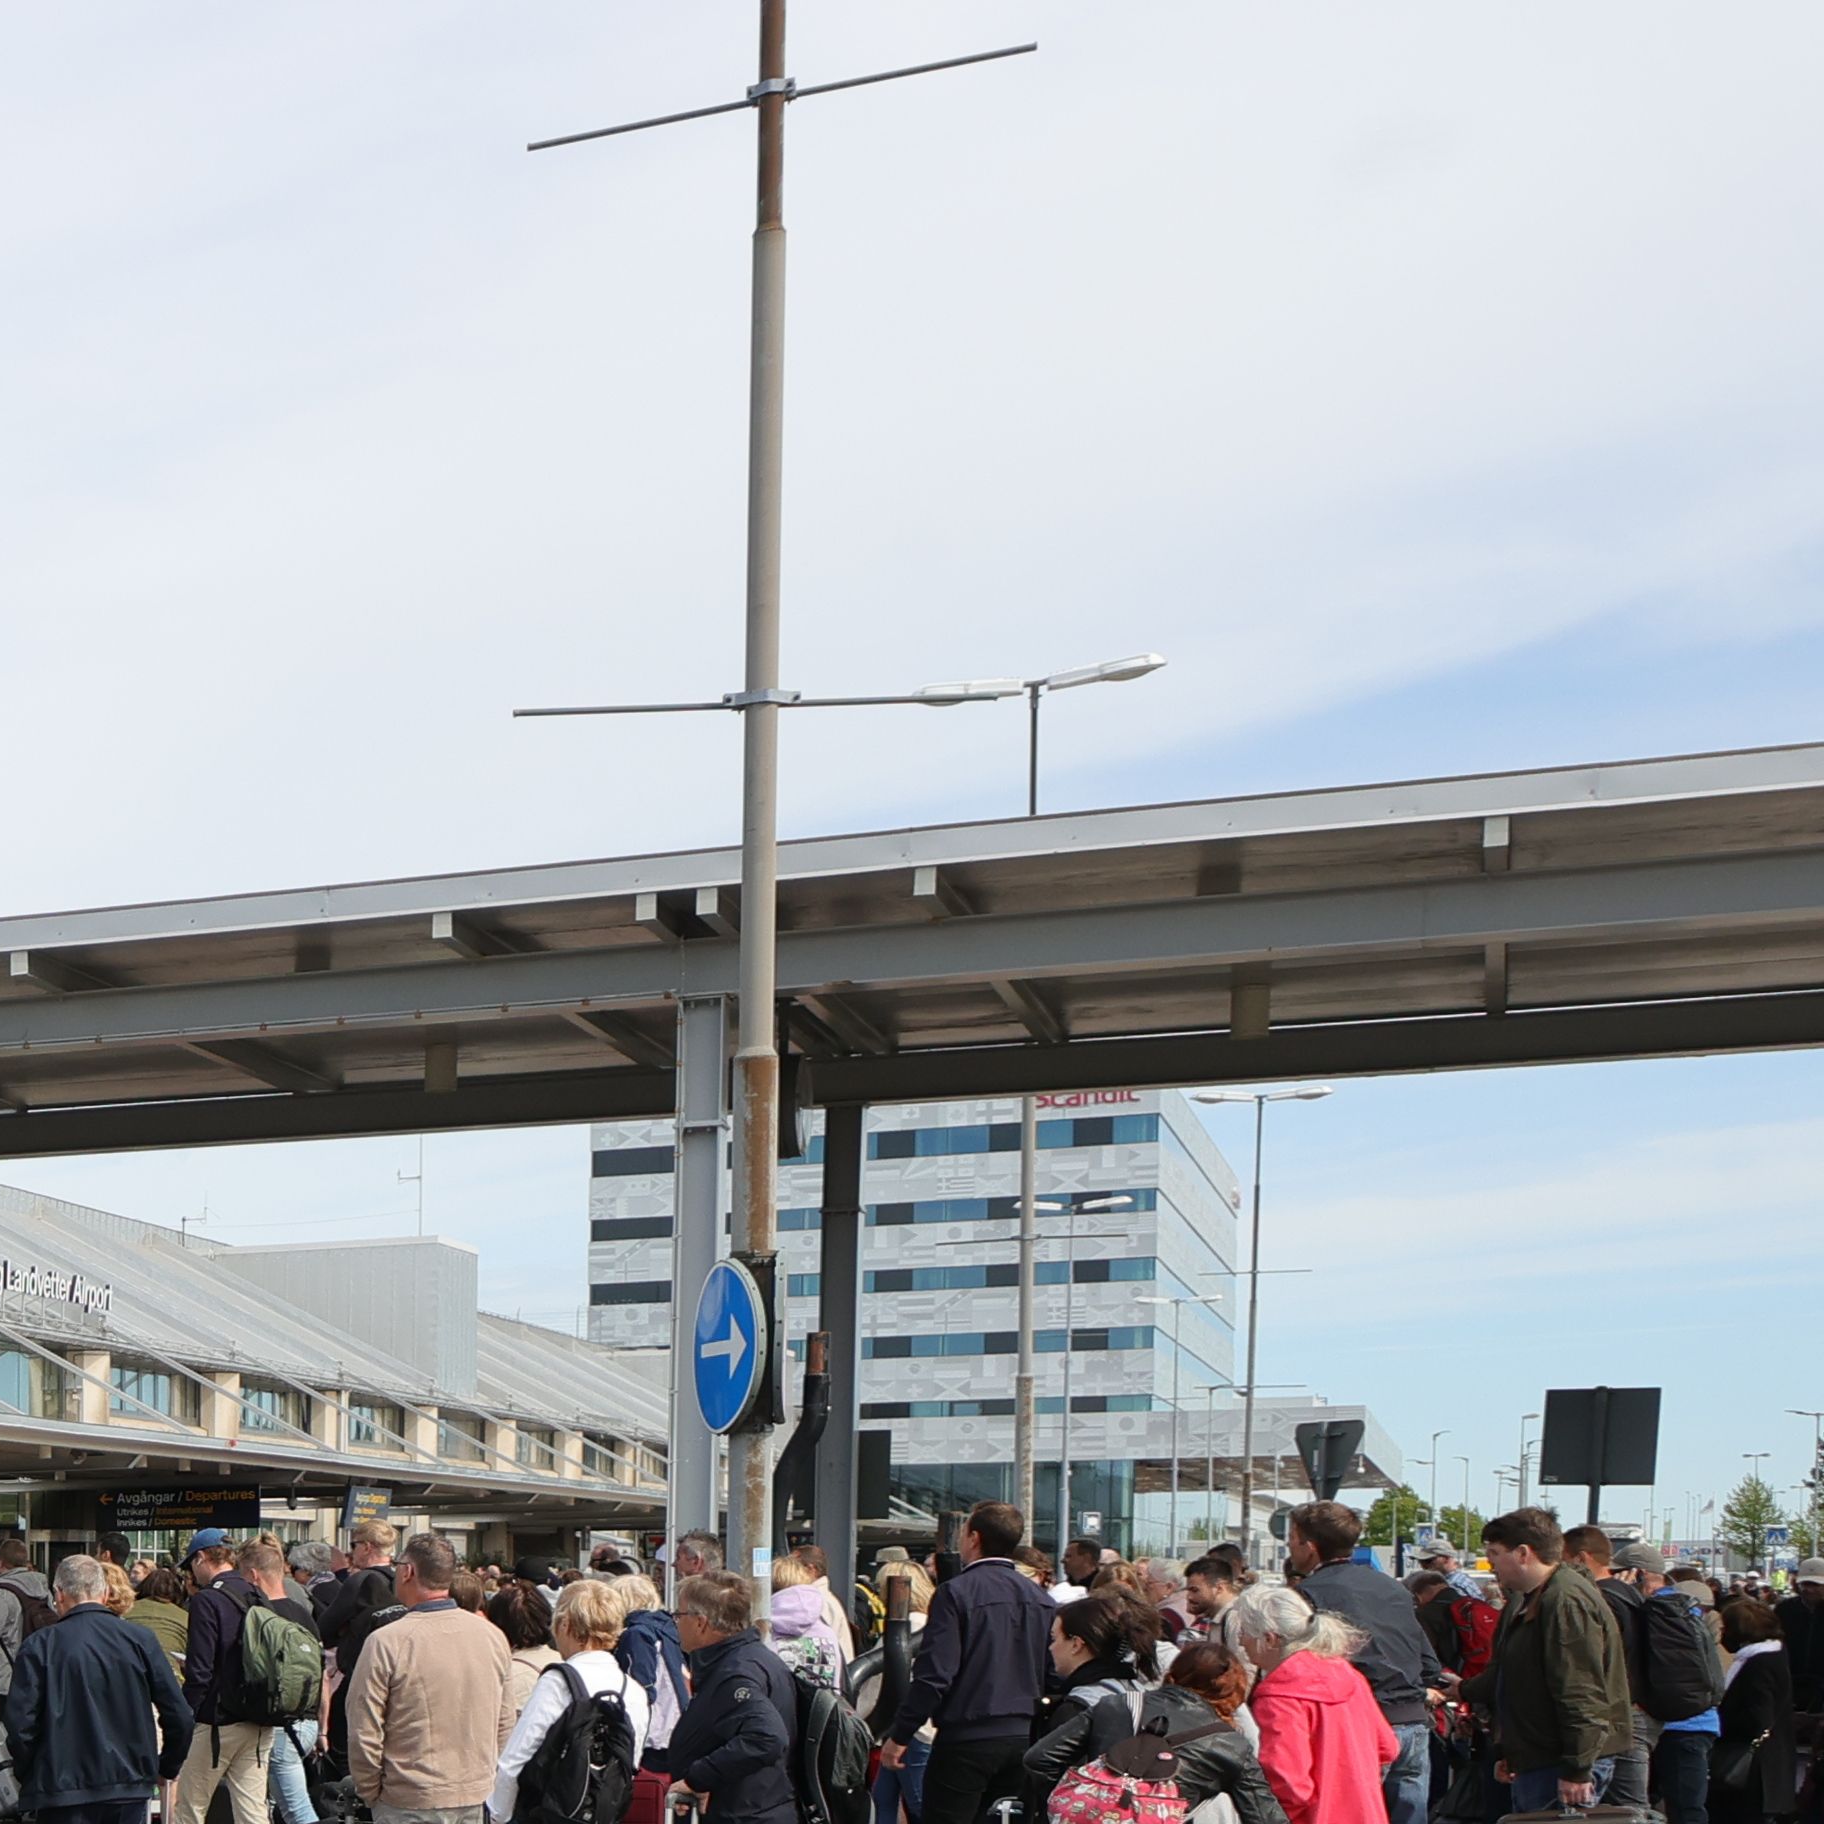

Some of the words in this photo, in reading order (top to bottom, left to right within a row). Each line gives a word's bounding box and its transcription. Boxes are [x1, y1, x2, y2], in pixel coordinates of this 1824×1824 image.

[4, 1260, 73, 1303] Landvetter
[70, 1274, 113, 1313] Airport
[117, 1490, 175, 1505] Avgångar
[185, 1489, 256, 1503] Departures
[116, 1507, 149, 1516] Utrikes
[156, 1506, 214, 1515] International
[154, 1517, 197, 1526] Domestic
